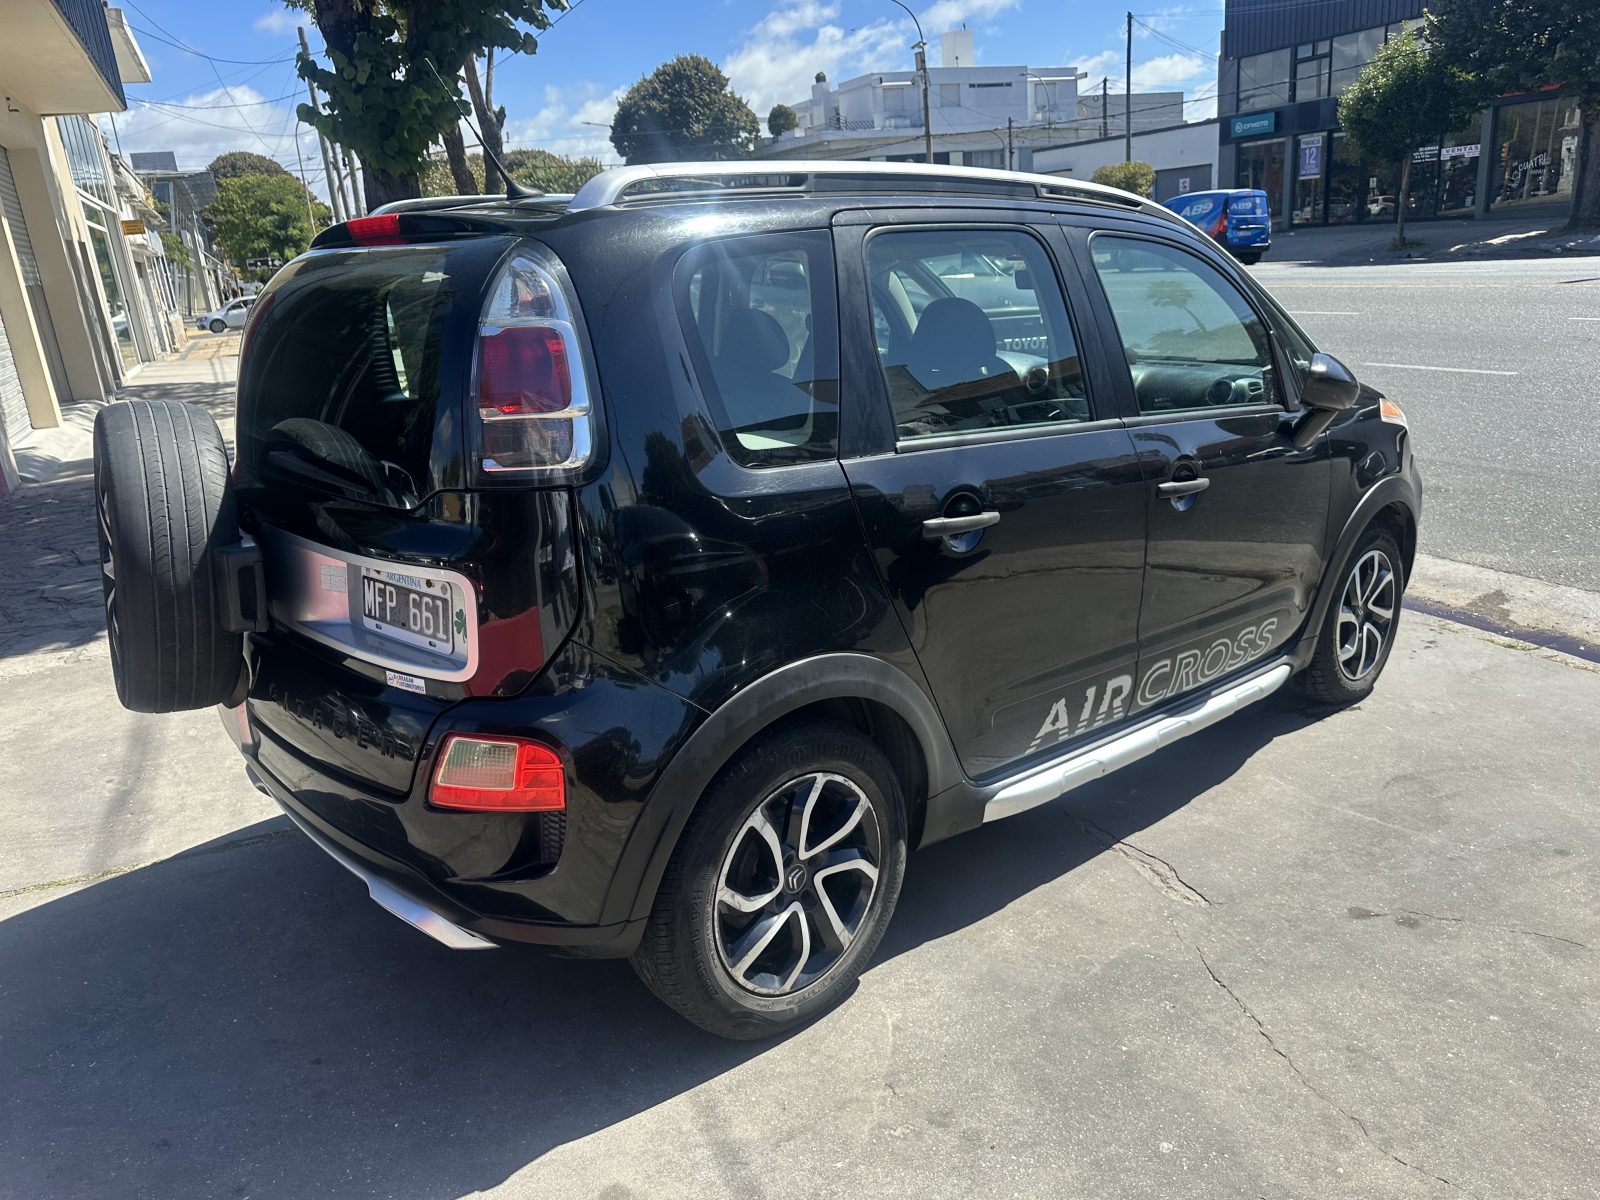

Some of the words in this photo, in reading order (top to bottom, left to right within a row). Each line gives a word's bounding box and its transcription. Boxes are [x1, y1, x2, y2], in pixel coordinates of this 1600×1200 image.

[1305, 147, 1317, 164] 12
[1445, 145, 1479, 154] VENTAS
[1003, 336, 1049, 350] TOYOT
[386, 571, 422, 590] ARGENTINA
[364, 578, 397, 622] MFP
[409, 593, 447, 640] 661
